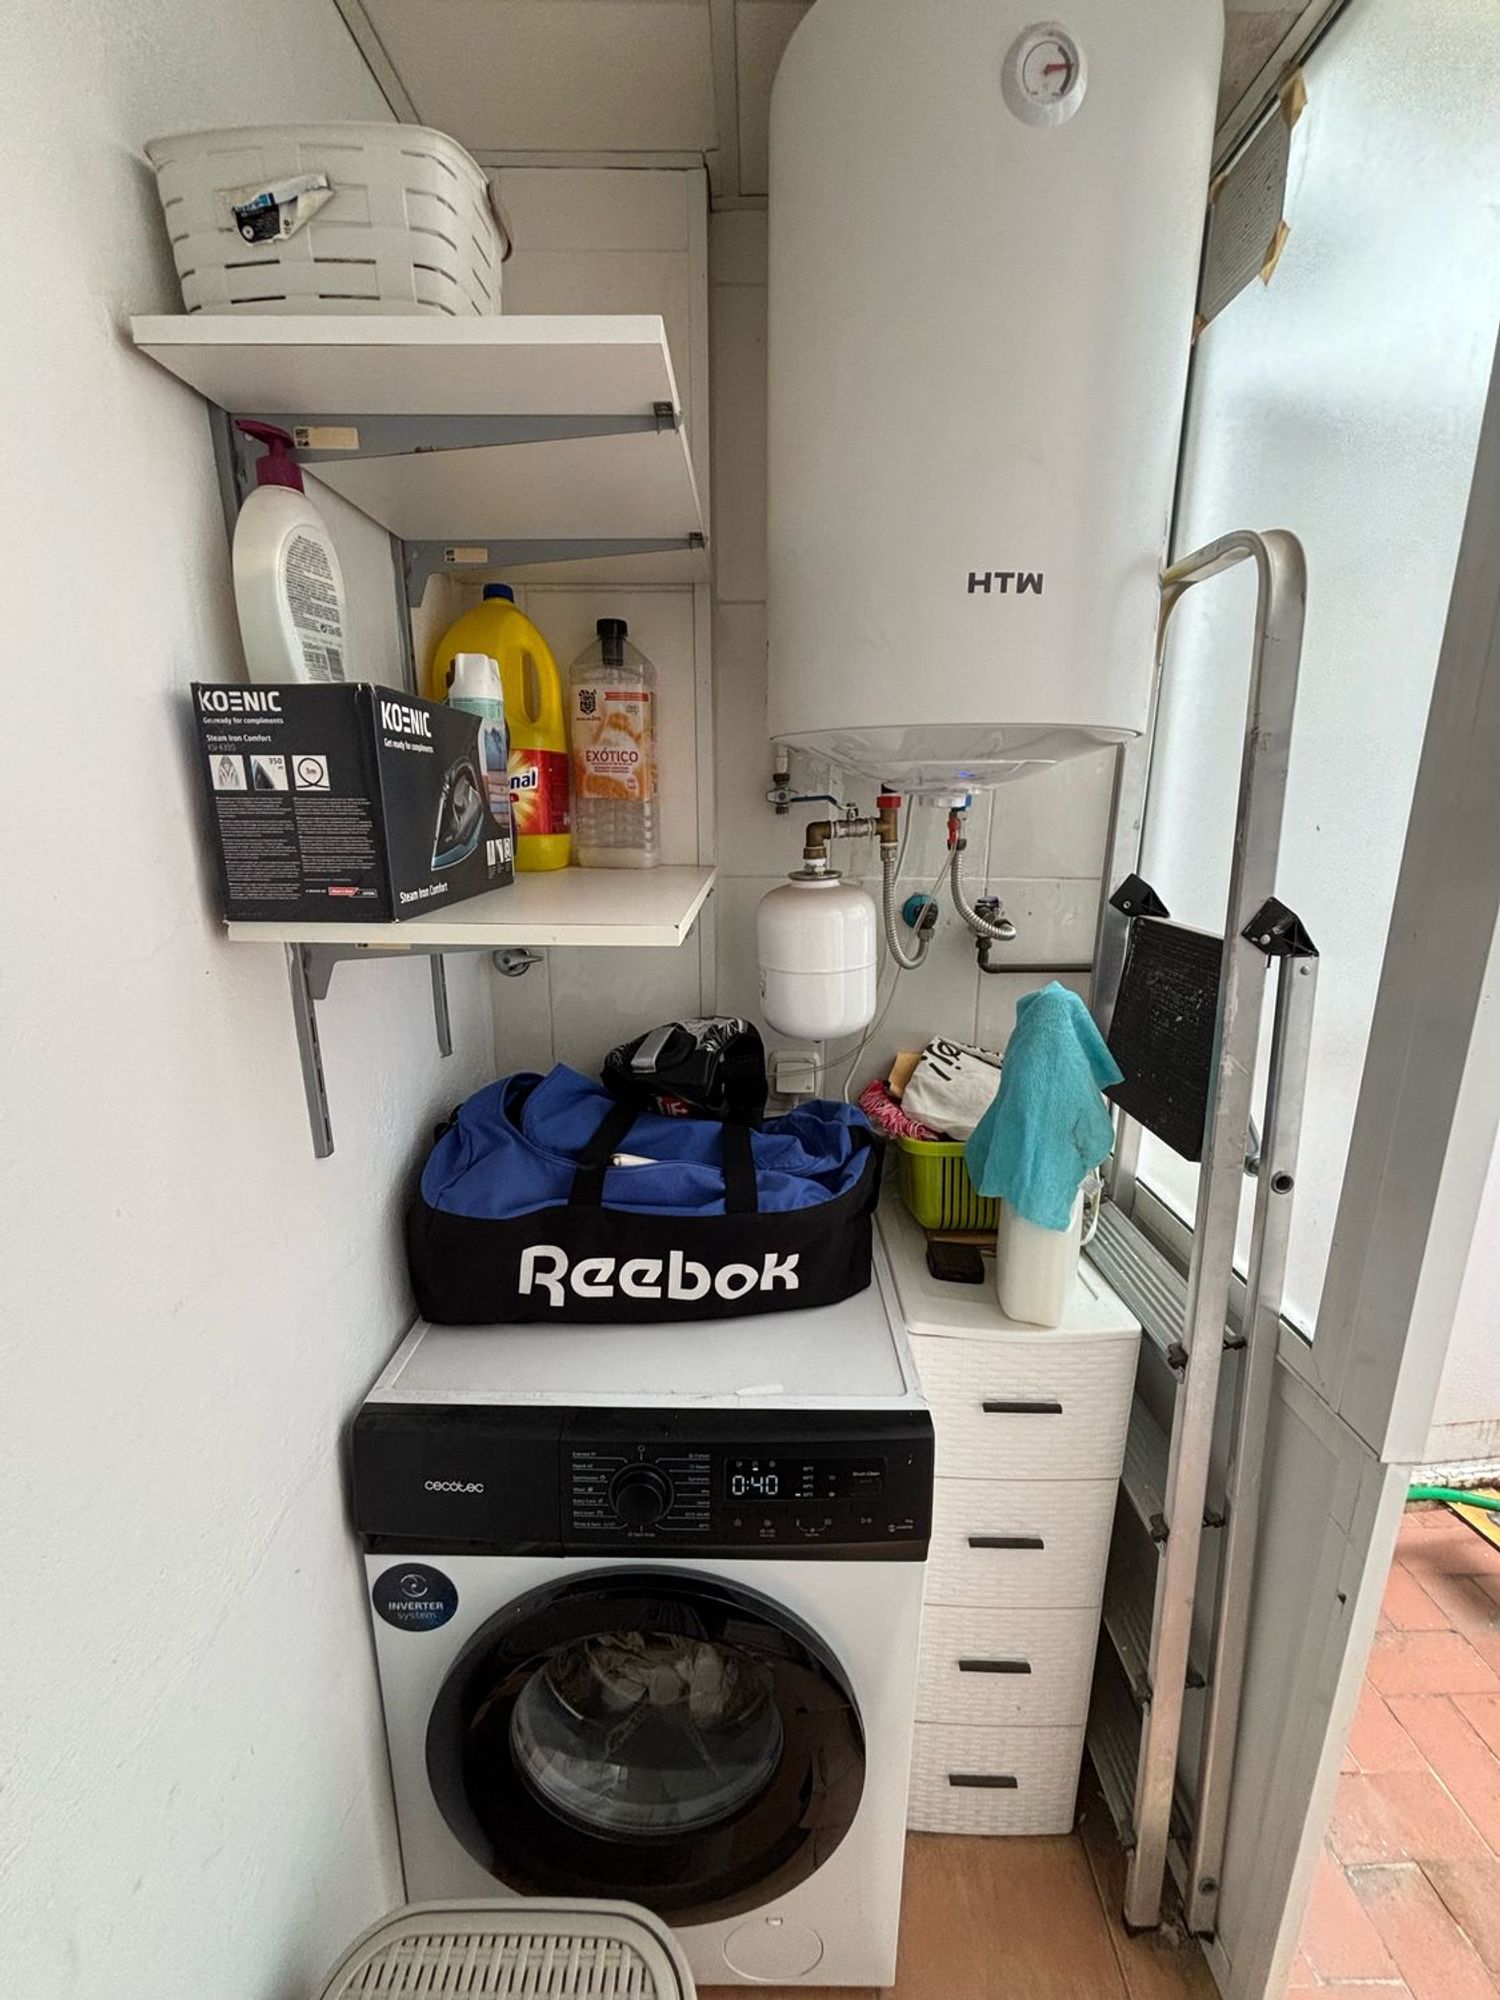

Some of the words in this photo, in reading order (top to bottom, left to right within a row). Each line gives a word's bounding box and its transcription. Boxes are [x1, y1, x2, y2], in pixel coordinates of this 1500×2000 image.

[967, 572, 1044, 595] HTW
[198, 690, 282, 712] KOENIC
[381, 700, 432, 738] KOENIC
[206, 734, 228, 742] Steam
[229, 734, 242, 742] Iron
[243, 734, 272, 742] Comfort
[586, 747, 639, 763] EXÓTICO
[510, 770, 536, 789] nal
[399, 890, 419, 904] Steam
[418, 887, 429, 899] Iron
[429, 882, 448, 896] Comfort
[518, 1245, 800, 1307] Reebok
[732, 1475, 778, 1496] 0:40
[388, 1601, 444, 1611] INVERTER
[397, 1611, 437, 1620] system
